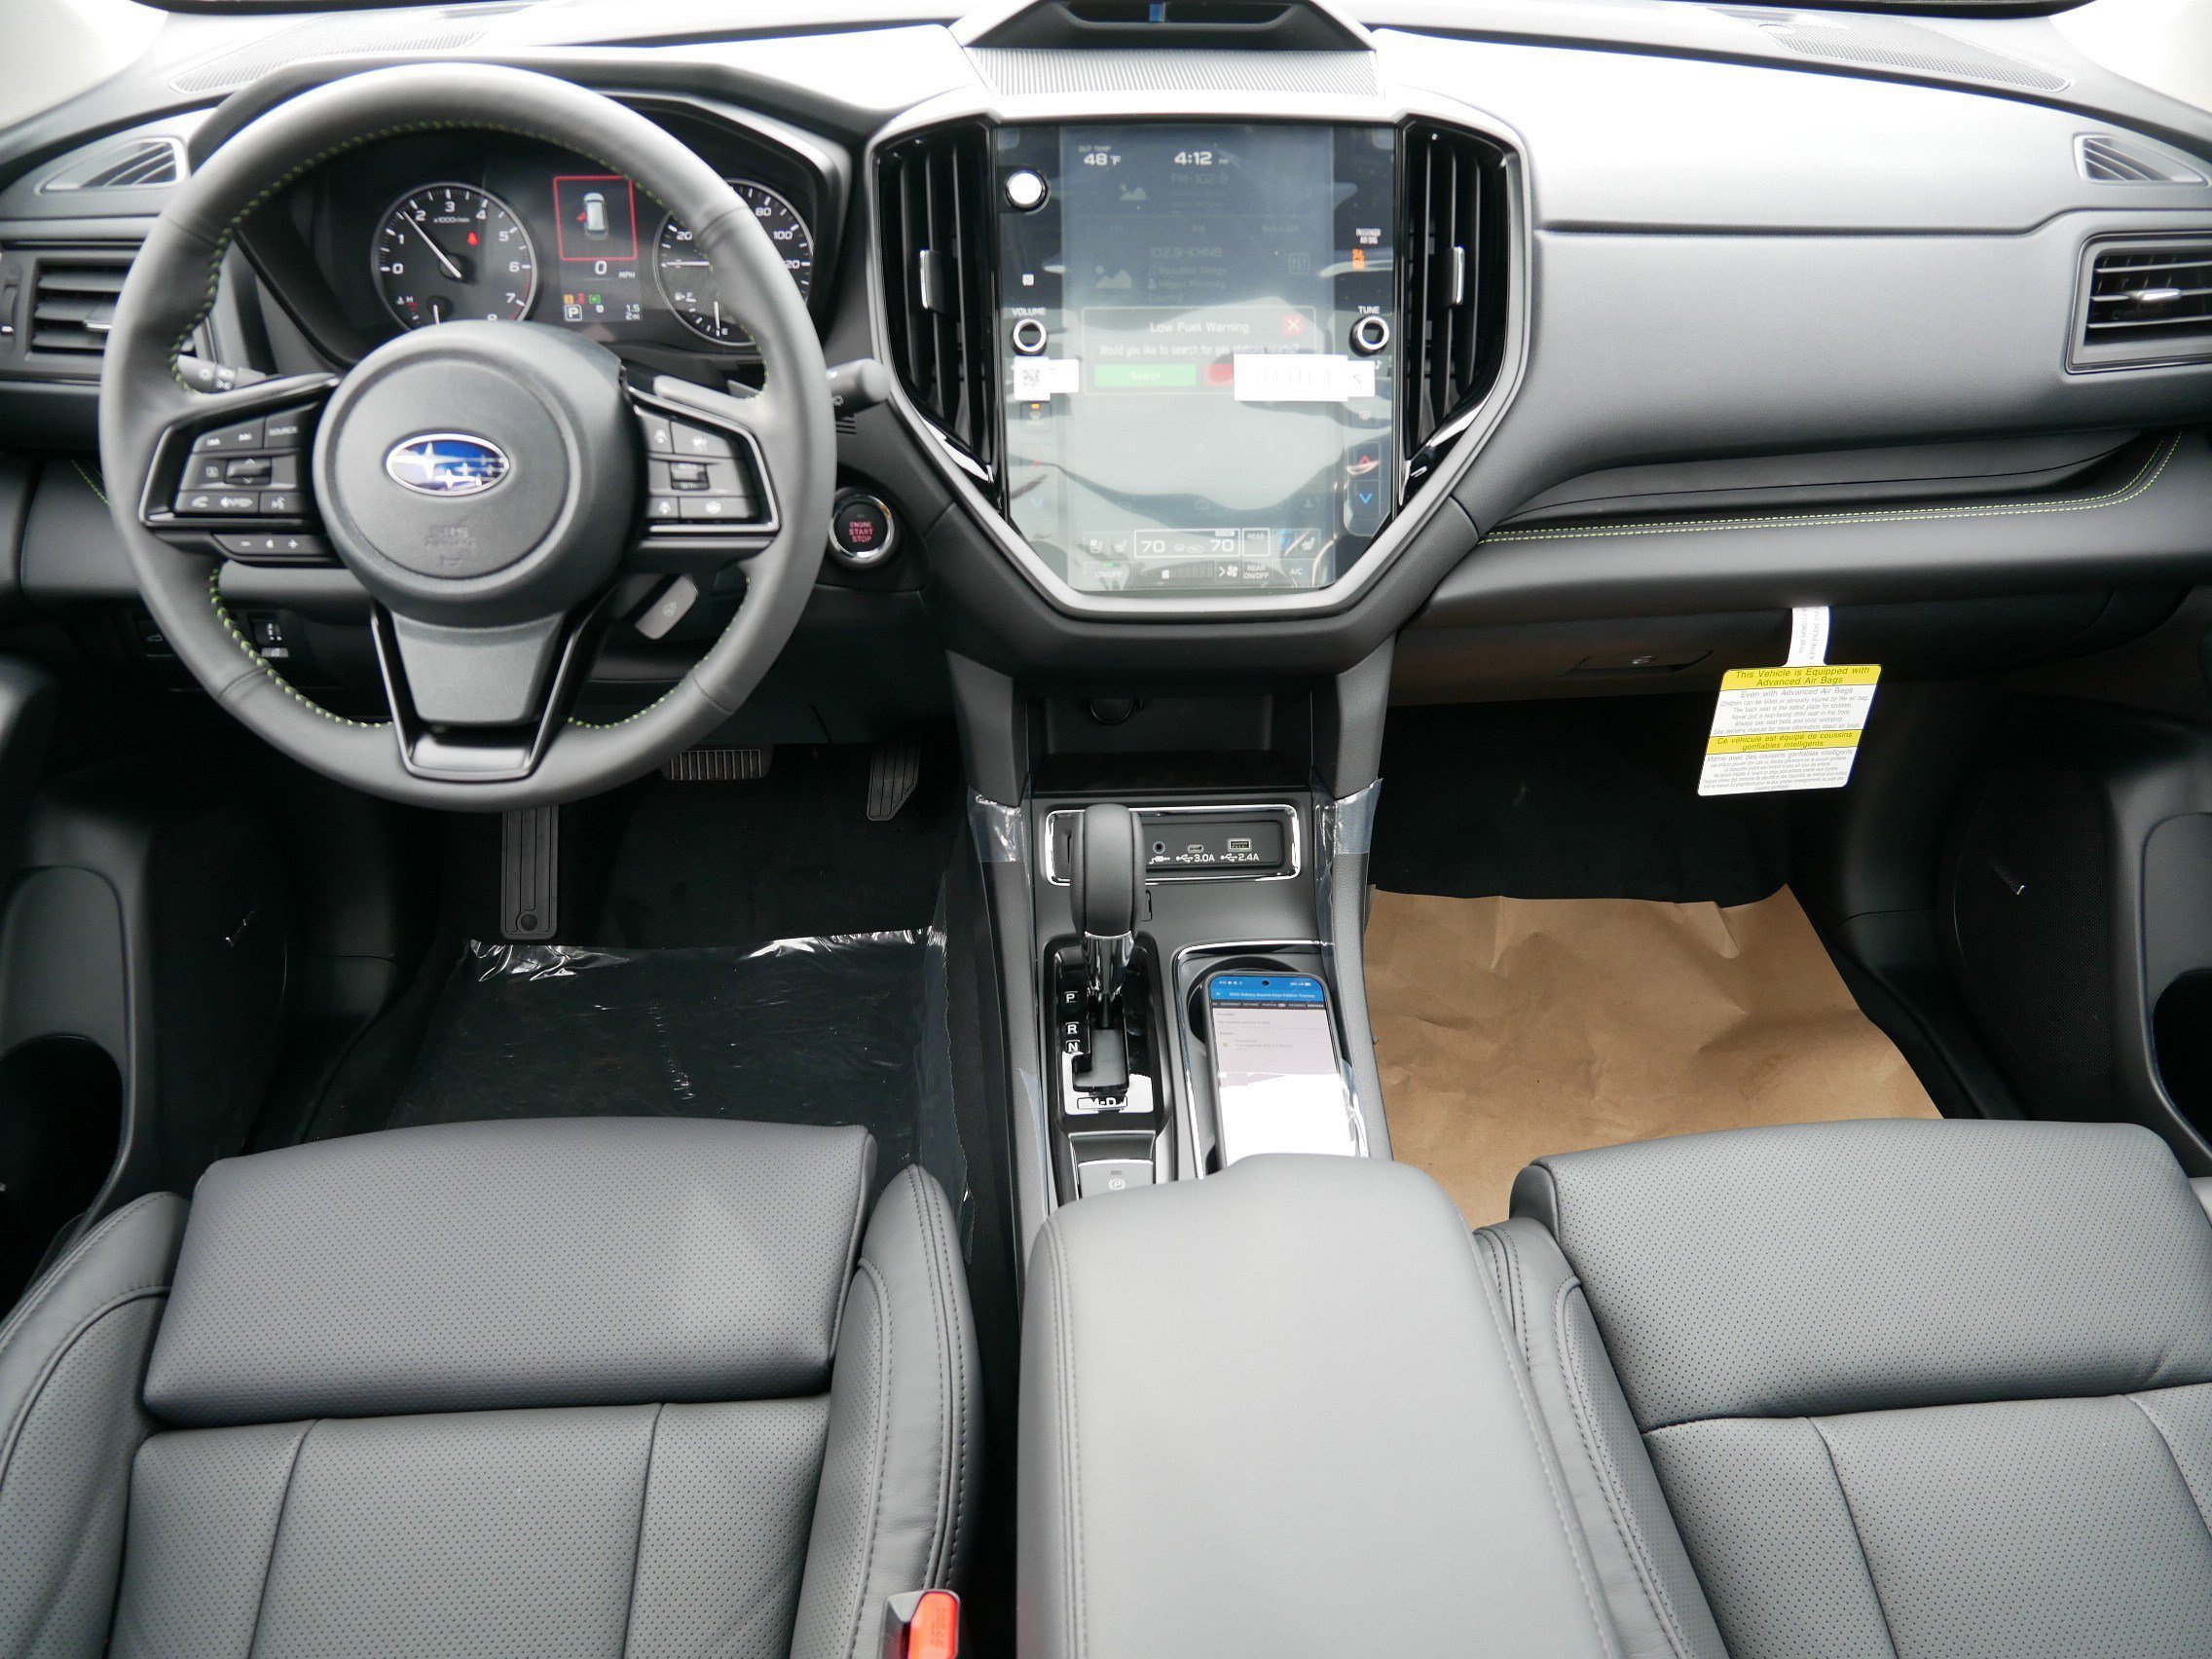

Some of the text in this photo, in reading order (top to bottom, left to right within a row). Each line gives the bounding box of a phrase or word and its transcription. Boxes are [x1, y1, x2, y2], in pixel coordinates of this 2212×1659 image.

[1083, 152, 1109, 166] 48
[1173, 151, 1213, 166] 4:12
[445, 201, 456, 213] 3
[755, 206, 772, 217] 80
[415, 209, 426, 222] 2
[476, 209, 487, 220] 4
[397, 234, 405, 244] 1
[498, 231, 509, 242] 5
[676, 231, 693, 240] 20
[773, 230, 793, 240] 100
[392, 262, 404, 275] 0
[508, 261, 520, 273] 6
[594, 260, 608, 276] 0
[505, 292, 515, 304] 7
[568, 307, 579, 318] P
[1011, 308, 1047, 316] VOLUME
[1357, 305, 1381, 314] TUNE
[1149, 321, 1250, 335] Low Fuel Warning
[1099, 345, 1124, 355] Would
[1125, 346, 1141, 357] you
[1142, 345, 1157, 355] like
[1160, 345, 1168, 355] to
[1171, 345, 1198, 355] search
[1200, 345, 1214, 355] for
[1129, 371, 1161, 382] Search
[1140, 539, 1165, 553] 70
[1209, 538, 1235, 552] 70
[1735, 666, 1870, 679] This Vehicle is Equipped with
[1755, 678, 1801, 686] Advanced
[1820, 676, 1843, 685] Bags
[1834, 686, 1854, 695] Bags
[1730, 735, 1762, 744] véhicule
[1784, 740, 1825, 749] intelligents
[1194, 854, 1216, 863] 3.0A
[1065, 992, 1076, 1002] P
[1067, 1024, 1077, 1034] R
[1068, 1042, 1079, 1052] N
